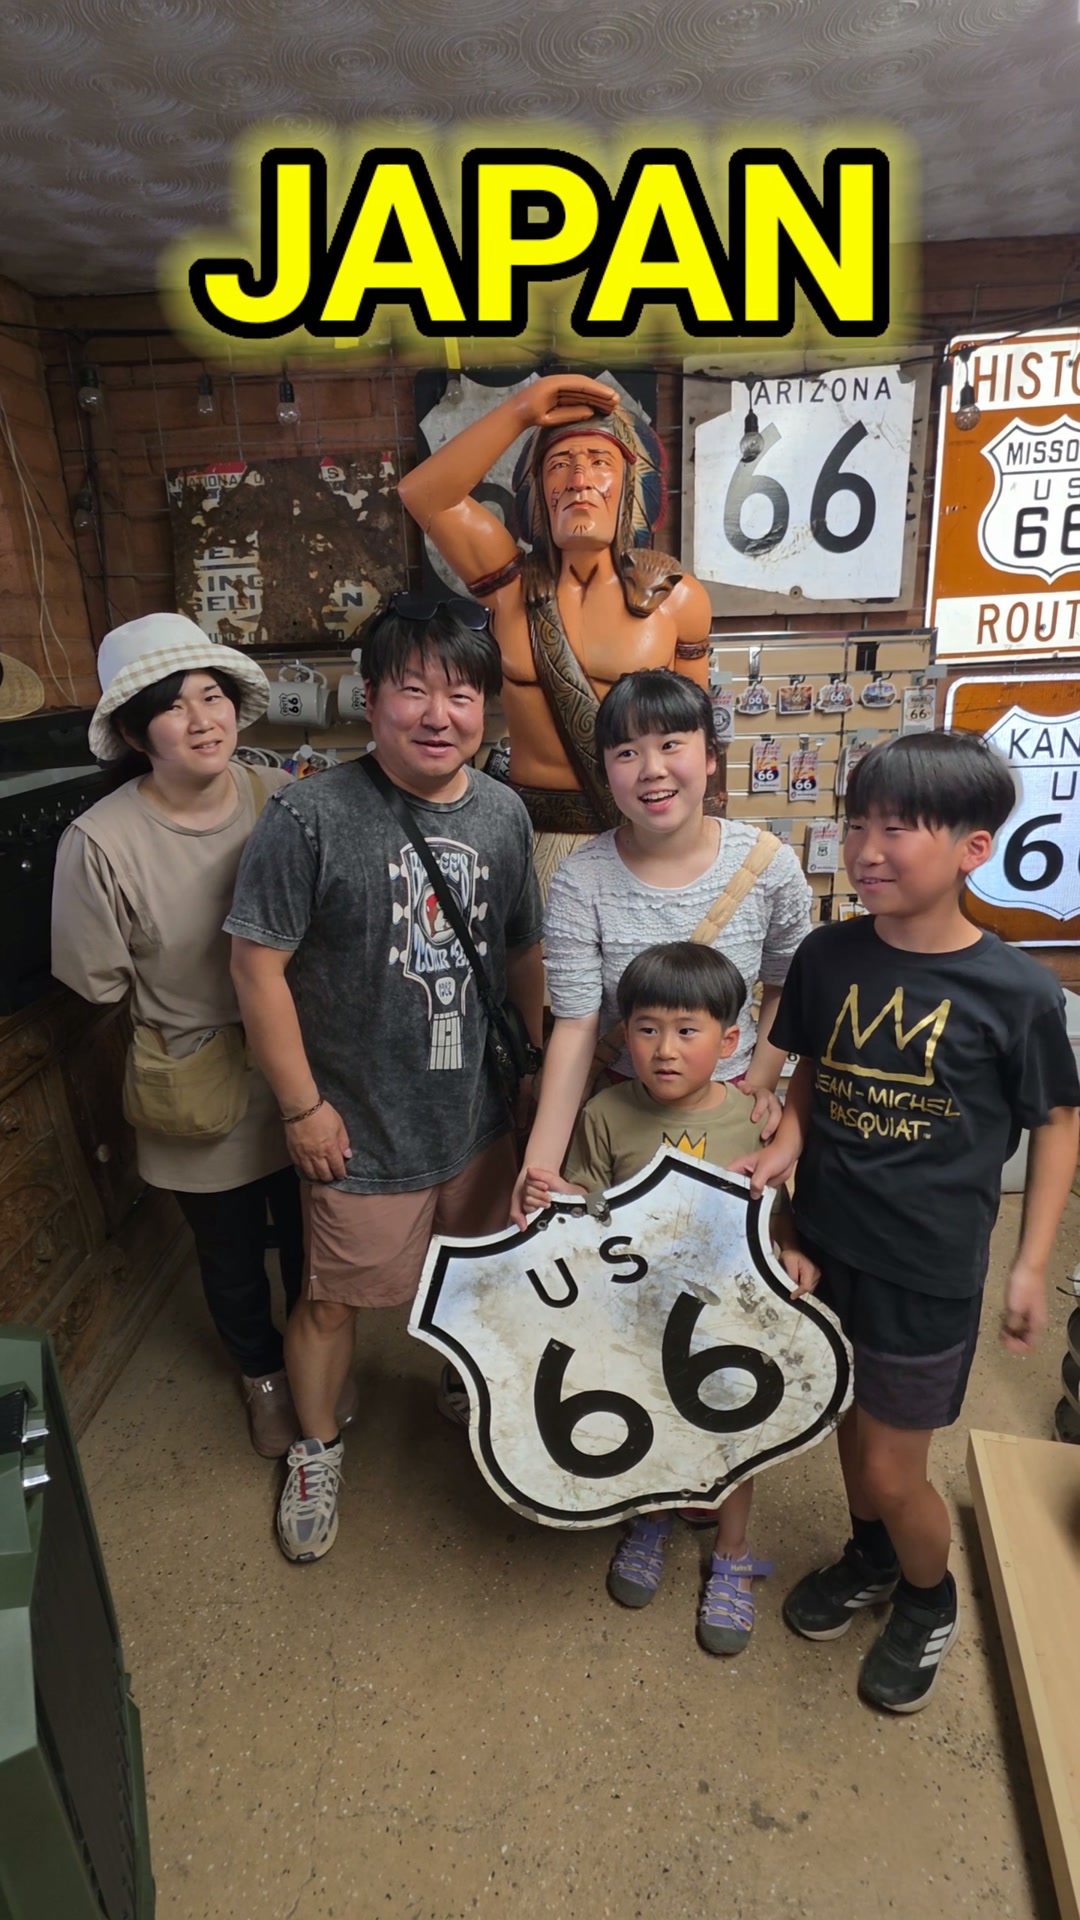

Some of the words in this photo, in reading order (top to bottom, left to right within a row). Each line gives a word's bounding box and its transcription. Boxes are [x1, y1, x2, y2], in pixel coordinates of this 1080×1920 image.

[753, 376, 892, 405] ARIZONA
[1006, 439, 1079, 466] MISSO
[179, 473, 242, 491] NATIONA
[723, 420, 877, 557] 66
[977, 600, 1080, 645] ROUT
[288, 697, 299, 713] 66
[749, 695, 762, 704] 66
[831, 692, 844, 702] 66
[911, 709, 927, 719] 66
[1009, 727, 1080, 760] KAN
[758, 770, 775, 781] 66
[795, 780, 812, 791] 66
[1052, 771, 1077, 801] U
[1003, 813, 1080, 892] 6
[534, 1291, 785, 1479] 66
